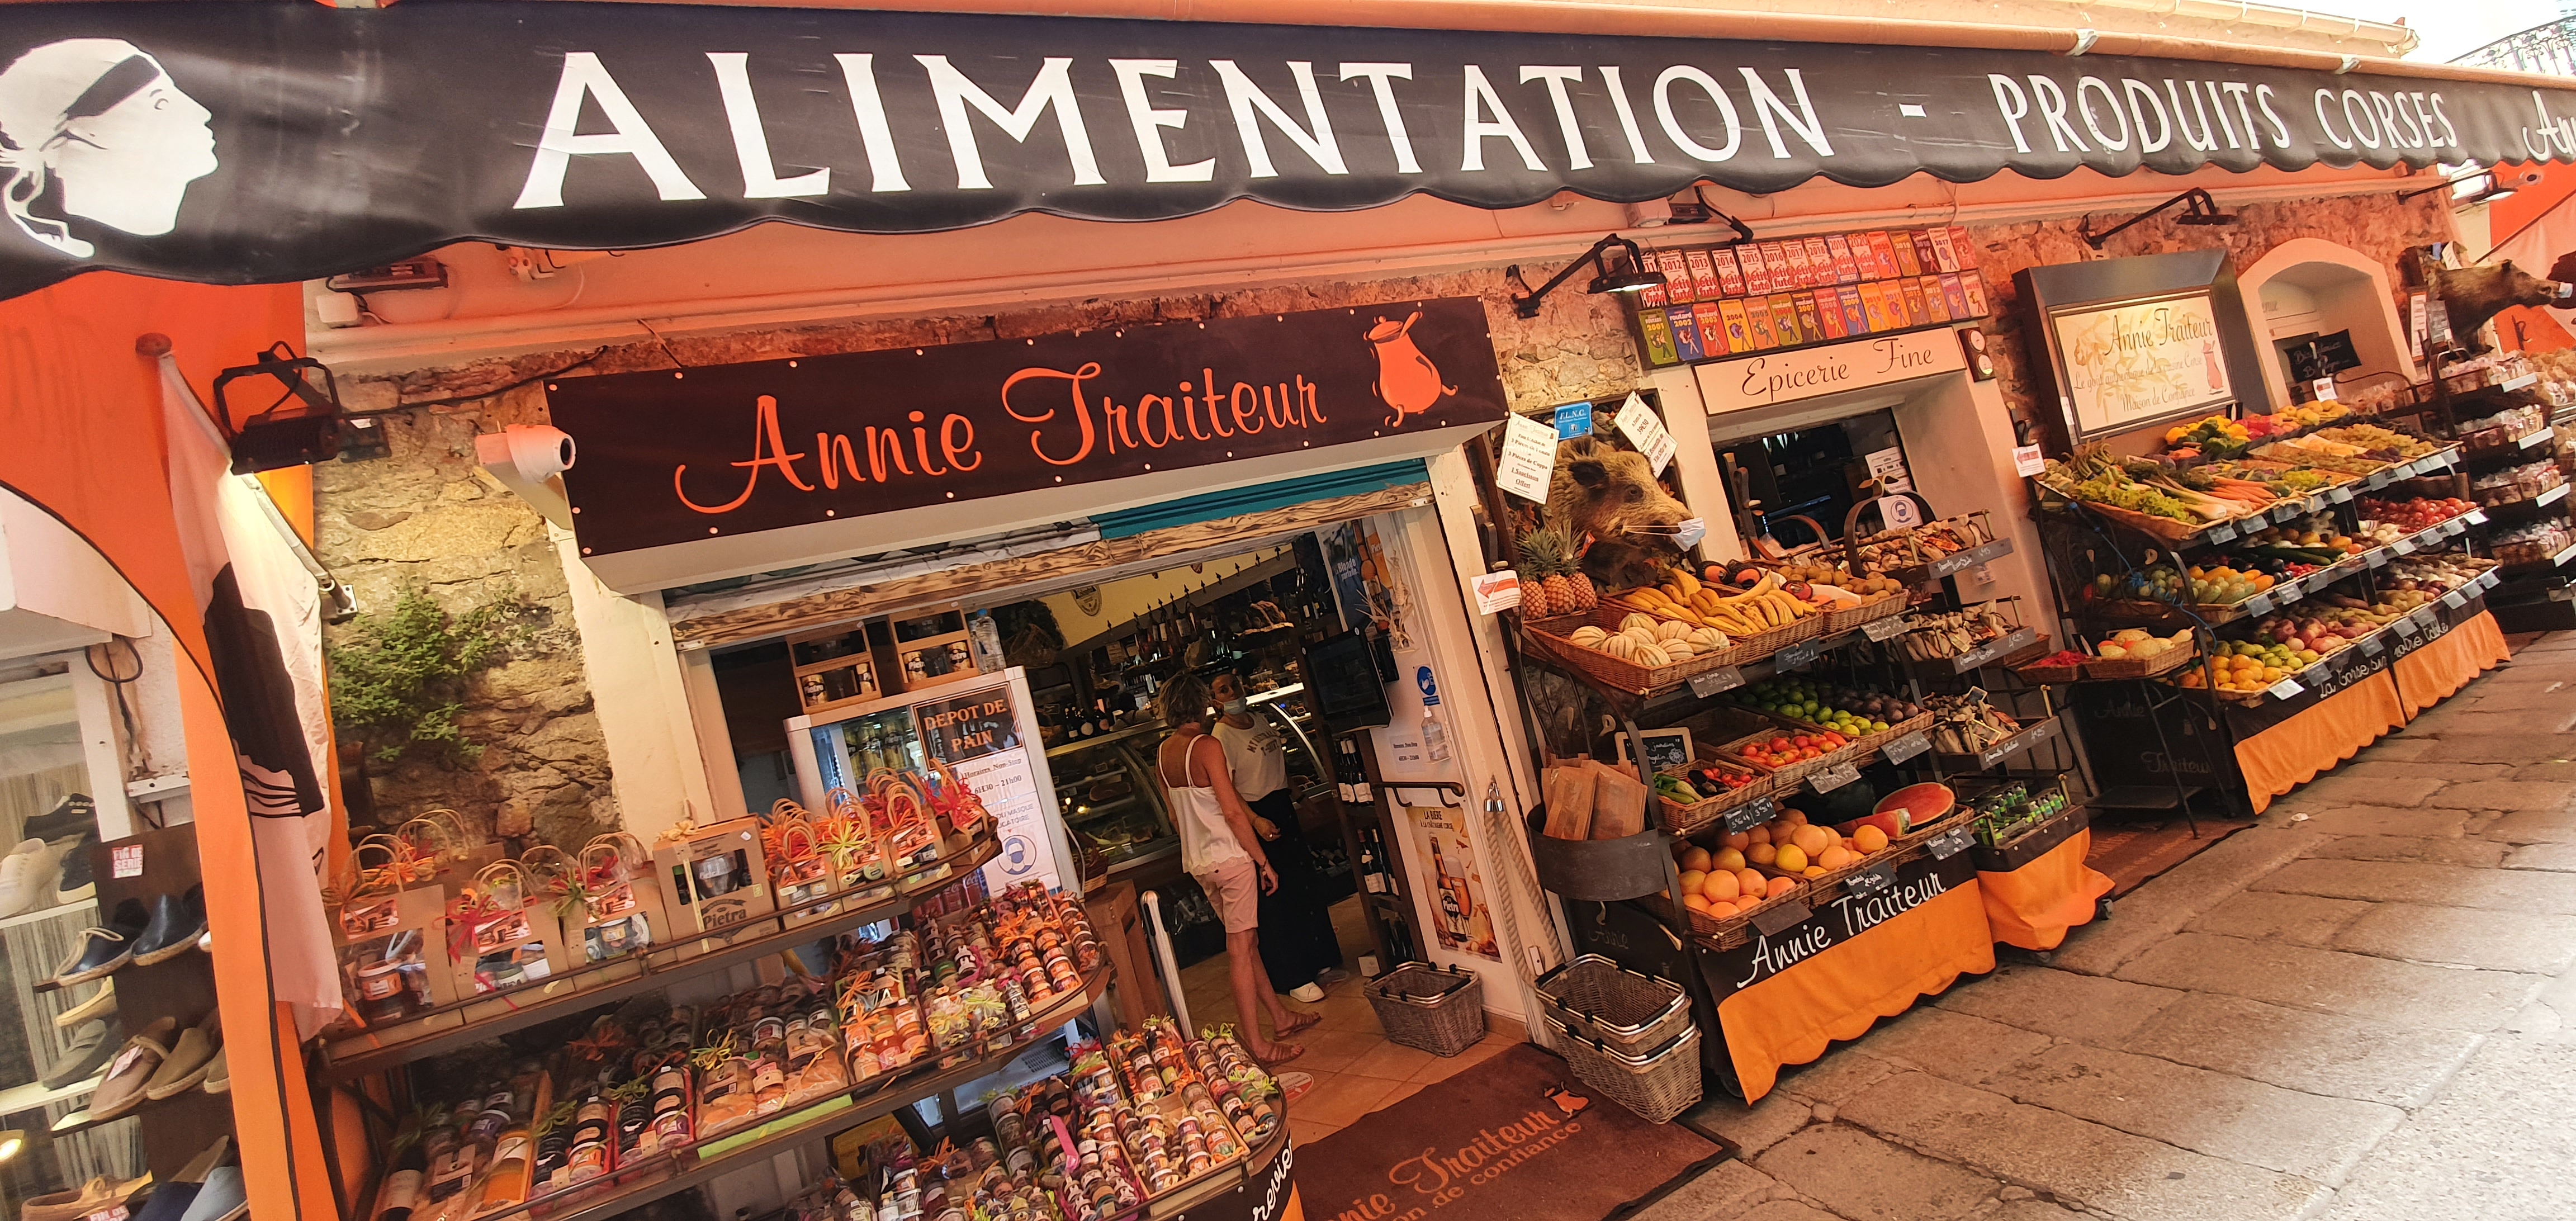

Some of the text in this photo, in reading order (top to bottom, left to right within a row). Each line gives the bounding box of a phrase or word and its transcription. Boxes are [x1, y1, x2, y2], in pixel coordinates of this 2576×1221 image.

[513, 51, 1833, 209] ALIMENTATION
[1987, 73, 2291, 154] PRODUITS
[2314, 87, 2459, 150] CORSES
[2522, 91, 2576, 161] An
[1829, 240, 1846, 250] 2019
[1849, 236, 1868, 248] 2020
[1788, 248, 1803, 258] 2017
[1809, 245, 1826, 255] 2018
[1690, 258, 1708, 269] 2013
[1716, 256, 1735, 267] 2014
[1742, 252, 1760, 263] 2015
[1765, 252, 1784, 263] 2016
[1834, 255, 1854, 266] petit
[1855, 252, 1876, 264] petit
[1663, 260, 1683, 271] 2012
[1768, 266, 1791, 278] petit
[1792, 263, 1813, 276] petit
[1813, 261, 1834, 273] petit
[1720, 275, 1743, 286] petit
[1745, 271, 1767, 282] petit
[1668, 279, 1691, 292] petit
[1693, 277, 1717, 290] petit
[1798, 305, 1815, 313] 2007
[1646, 323, 1665, 332] 2001
[2104, 308, 2213, 356] Annie Traiteur
[1742, 338, 1935, 401] Epicerie Fine
[2074, 371, 2085, 391] Le
[2121, 393, 2151, 412] Maison
[2153, 387, 2161, 406] de
[674, 362, 1328, 514] Annie Traiteur
[1371, 543, 1383, 553] Pietr
[2320, 681, 2336, 698] La
[2335, 665, 2369, 686] Corse
[924, 699, 1007, 731] DEPOT DE
[951, 730, 993, 753] PAIN
[1247, 740, 1258, 753] MY
[964, 758, 1022, 778] Horaires Non-Stop
[974, 783, 994, 794] 6H30
[1001, 775, 1022, 787] 21h00
[1007, 803, 1034, 816] MASQUE
[702, 908, 746, 930] Pietra
[1736, 871, 1947, 989] Annie Traiteur
[1388, 1109, 1561, 1194] Traiteur
[1432, 1121, 1581, 1206] de confiance
